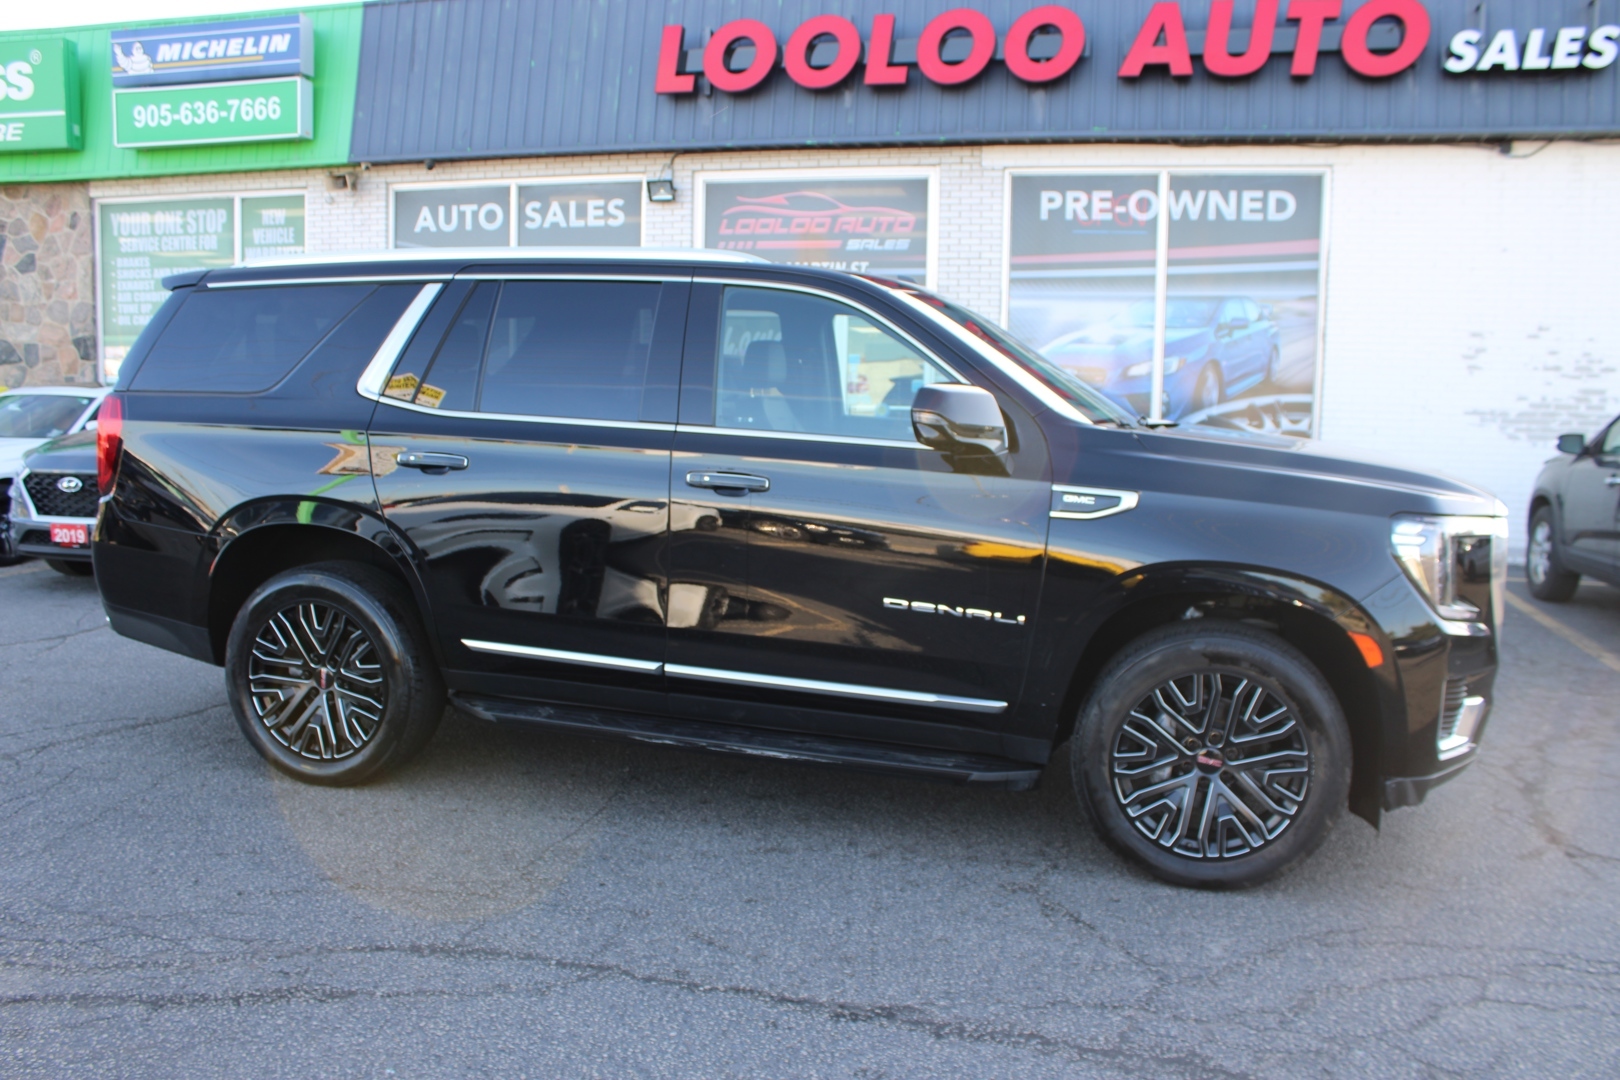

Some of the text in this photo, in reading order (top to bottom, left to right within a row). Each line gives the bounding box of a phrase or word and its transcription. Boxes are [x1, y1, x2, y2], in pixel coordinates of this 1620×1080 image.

[155, 33, 293, 63] MICHELIN
[655, 0, 1620, 95] LOOLOO AUTO SALES
[133, 95, 282, 129] 905-636-7666
[413, 198, 625, 233] AUTO SALES
[1039, 188, 1297, 222] PRE-OWNED
[110, 208, 227, 237] YOUR ONE STOP
[252, 227, 295, 245] VEHICLE
[718, 215, 916, 236] LOOLOO AUTO
[119, 233, 218, 253] SERVICE CENTRE FOR
[845, 238, 911, 251] SALES
[1062, 493, 1096, 505] GMC
[55, 527, 85, 544] 2019
[882, 596, 1026, 626] DENALI
